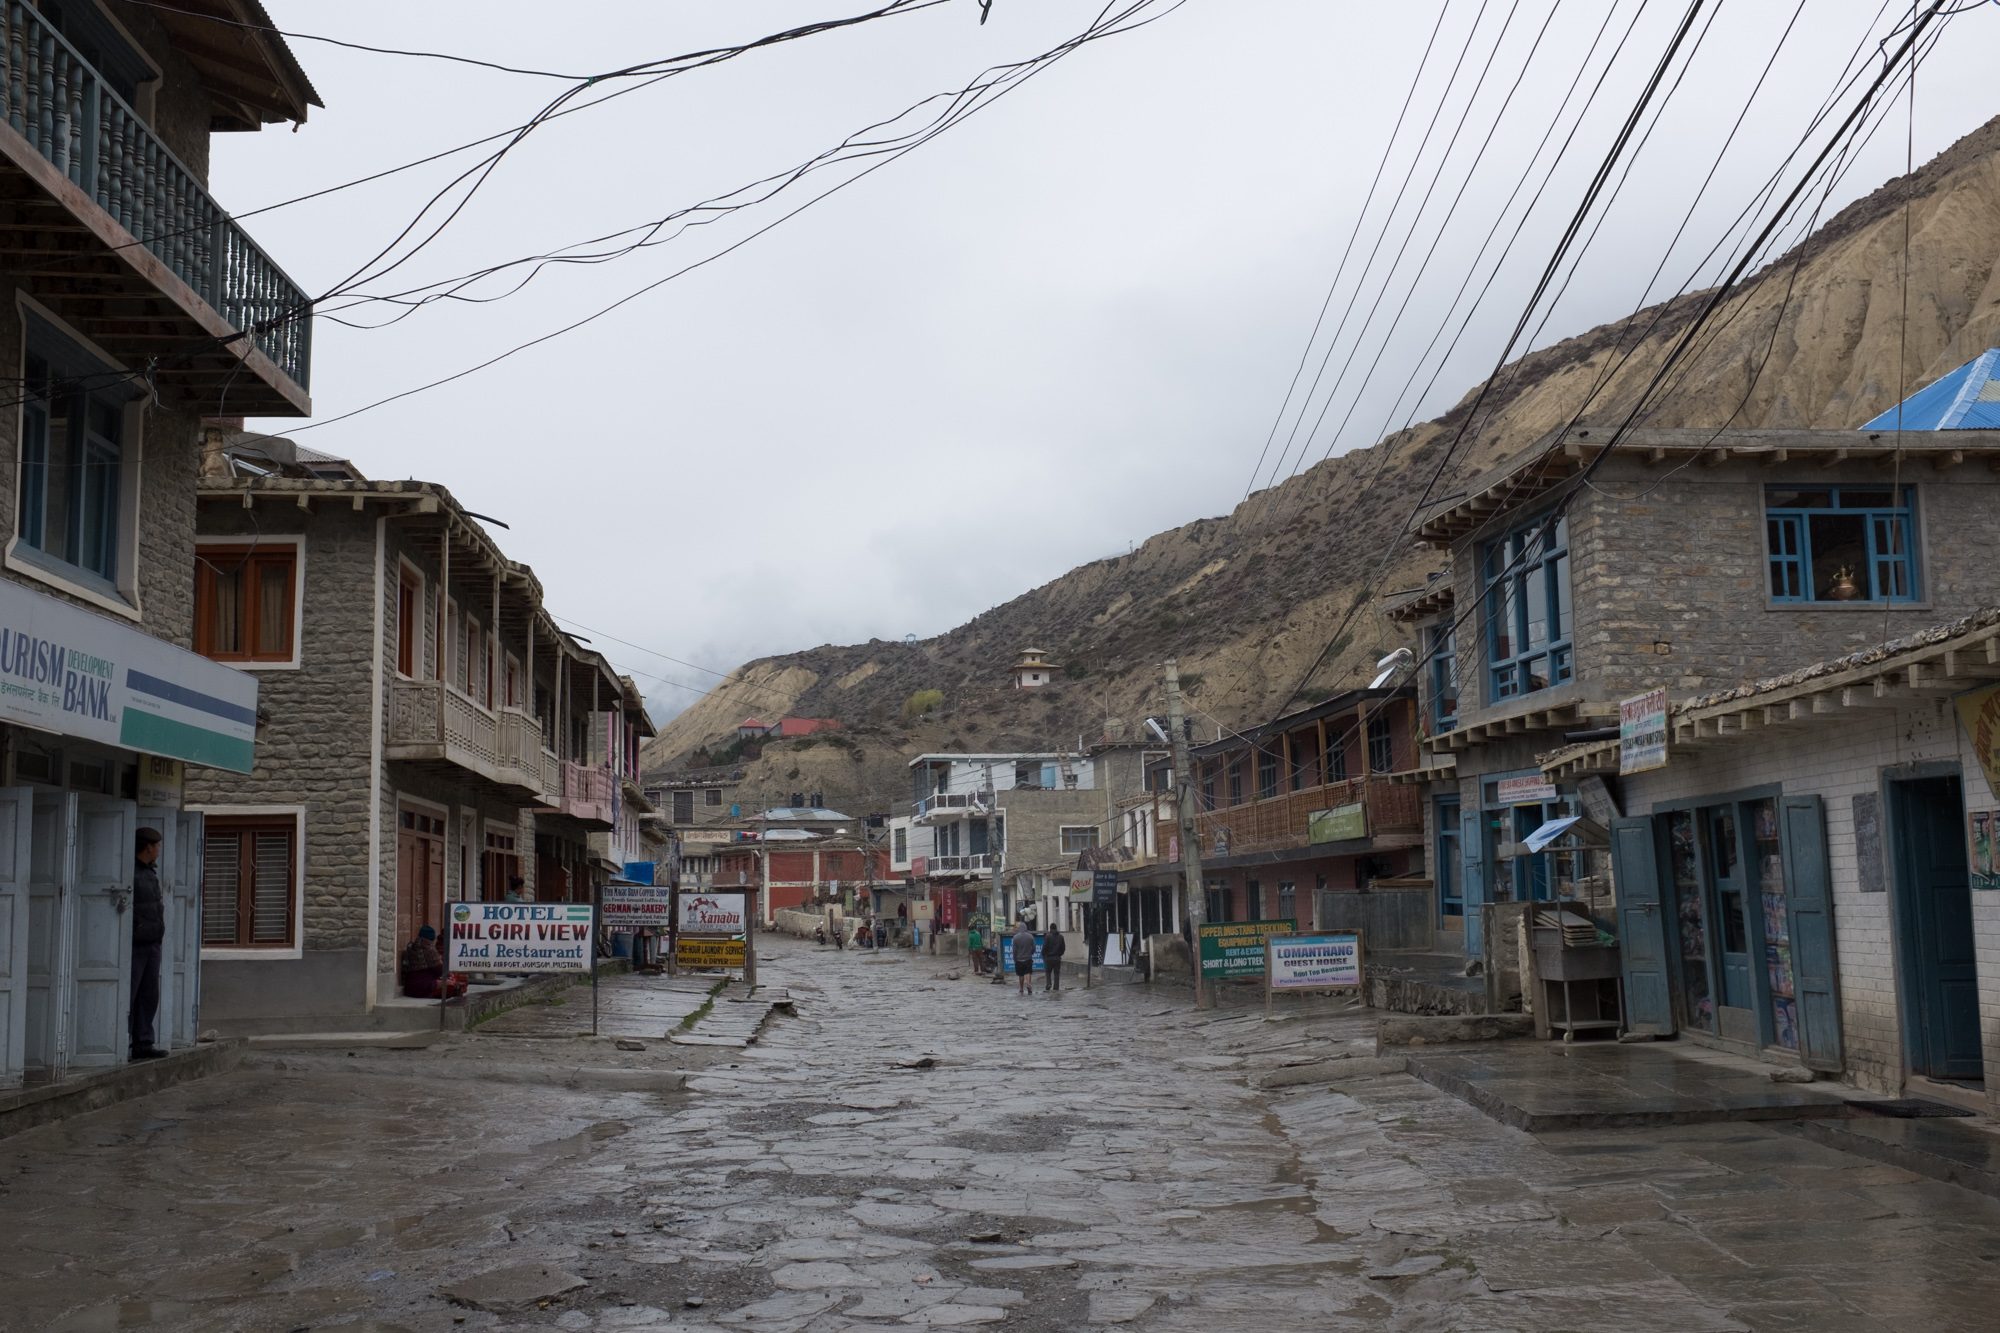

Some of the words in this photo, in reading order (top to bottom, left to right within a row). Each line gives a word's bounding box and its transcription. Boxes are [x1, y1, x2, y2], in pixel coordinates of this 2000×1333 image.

[0, 628, 65, 688] URISM
[68, 649, 115, 680] DEVELOPMENT
[63, 670, 111, 721] BANK
[1072, 878, 1092, 890] Real
[483, 906, 562, 921] HOTEL
[603, 904, 631, 913] GERMAN
[641, 904, 668, 914] BAKERY
[699, 911, 740, 924] Xanadu
[453, 924, 531, 941] NILGIRI
[537, 924, 589, 941] VIEW
[1200, 926, 1223, 938] UPPER
[1223, 924, 1255, 937] MUSTANG
[1255, 923, 1292, 935] TREKKING
[1218, 937, 1257, 948] EQUIPMENT
[458, 943, 489, 958] And
[496, 944, 583, 958] Restaurant
[679, 945, 701, 954] ONE-HOUR
[701, 945, 725, 955] LAUNDRY
[725, 946, 745, 955] SERVICE
[1225, 948, 1240, 957] RENT
[1277, 945, 1354, 959] LOMANTHANG
[679, 957, 702, 965] WASHER
[709, 957, 729, 965] DRYER
[1202, 959, 1223, 969] SHORT
[1224, 958, 1230, 968] &
[1229, 957, 1247, 968] LONG
[1283, 959, 1314, 968] GUEST
[1316, 957, 1348, 967] HOUSE
[1308, 969, 1321, 977] Top
